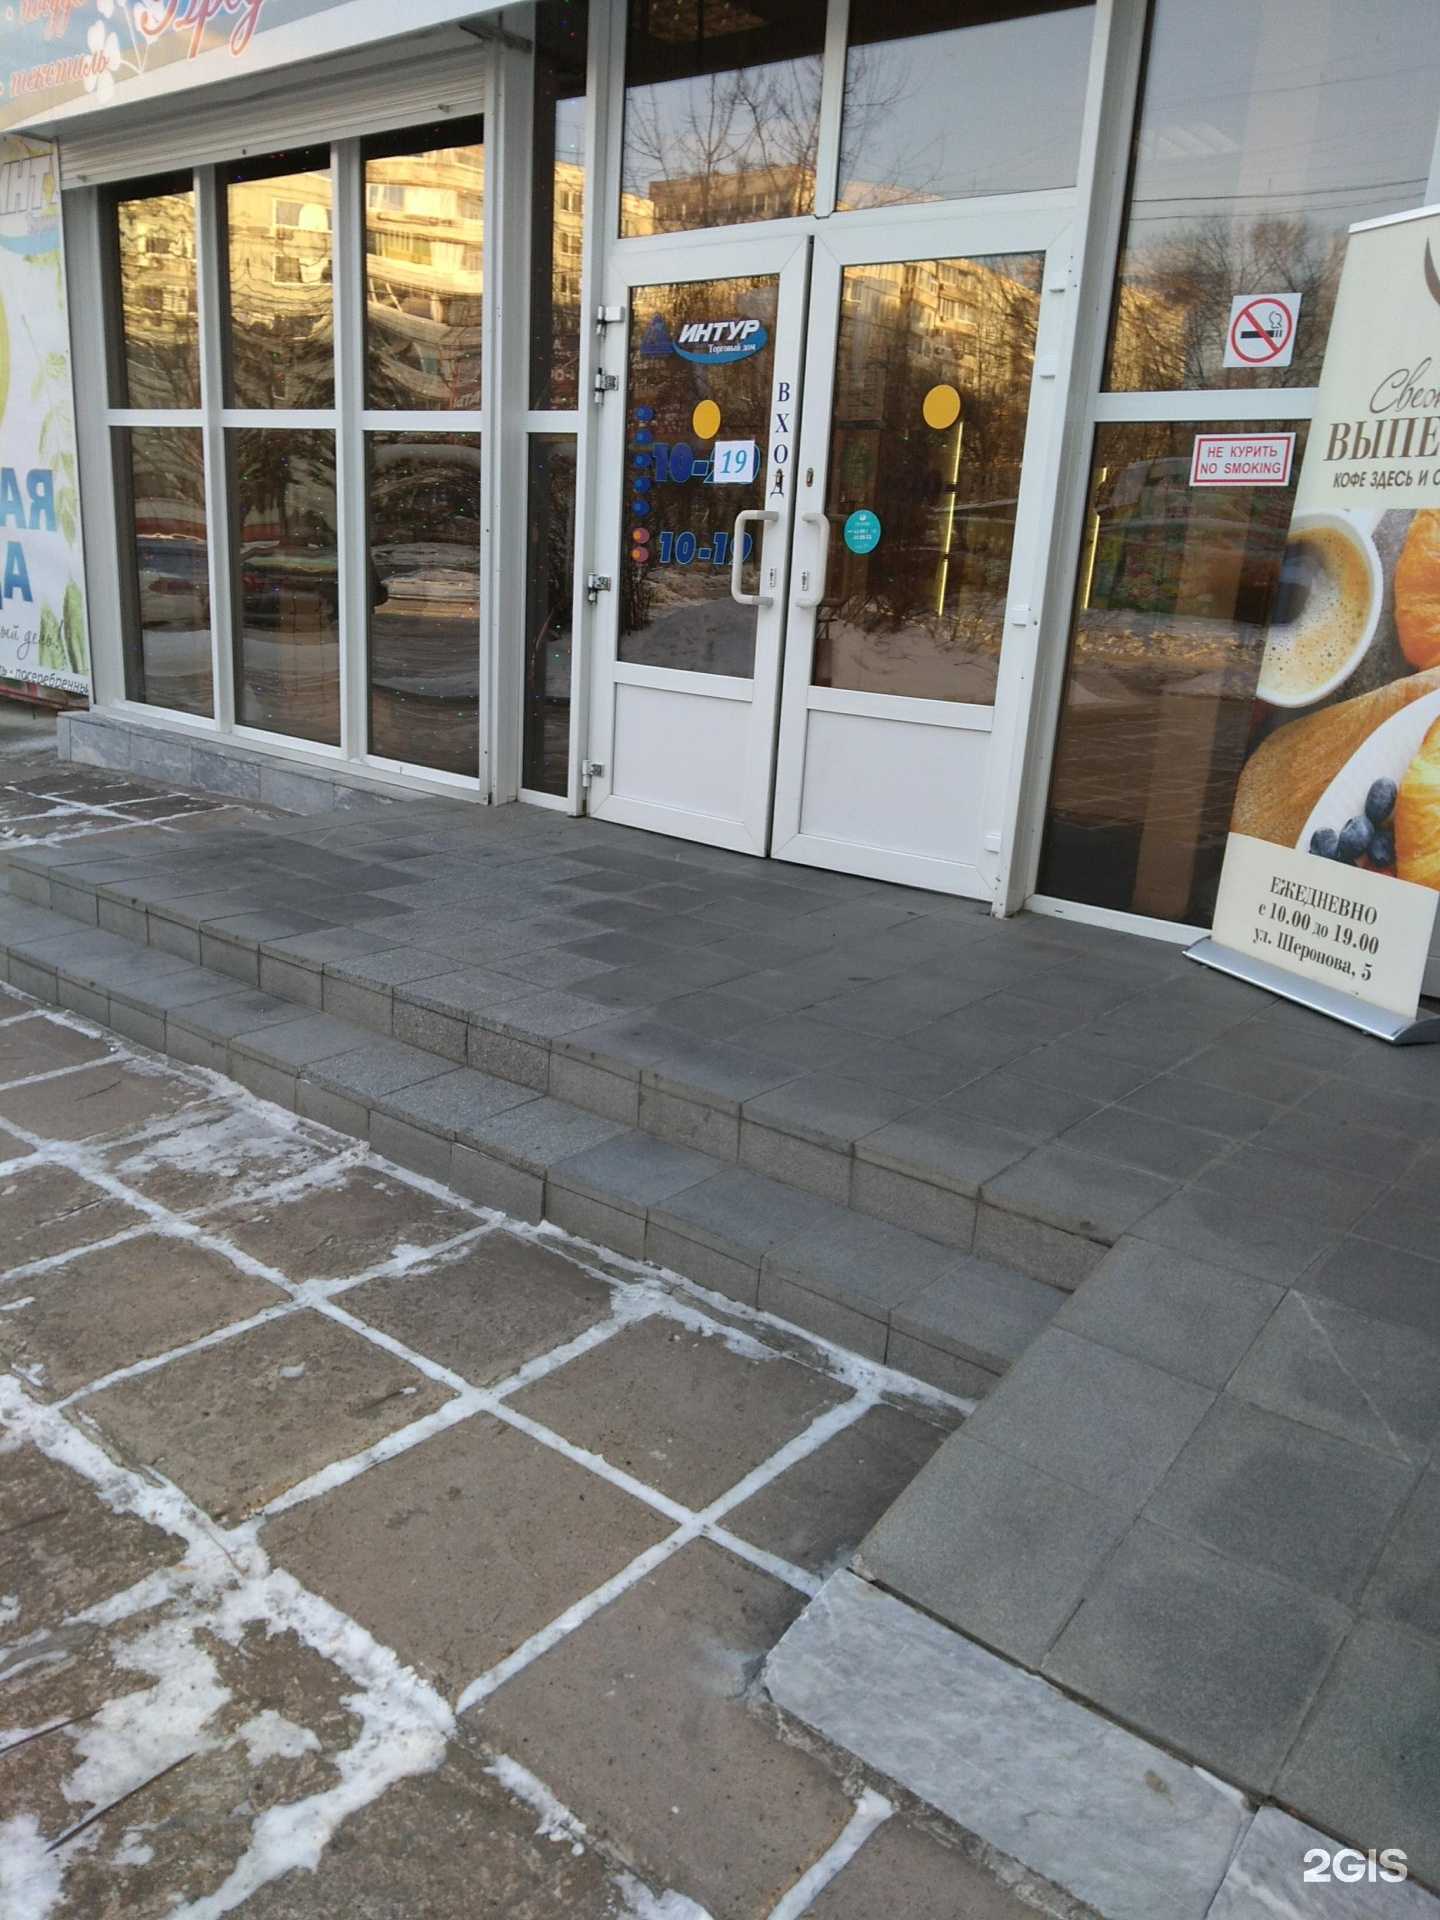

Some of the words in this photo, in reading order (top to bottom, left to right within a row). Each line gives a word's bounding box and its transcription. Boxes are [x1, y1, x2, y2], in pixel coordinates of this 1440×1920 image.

[679, 319, 760, 343] ИНТУР
[770, 382, 790, 498] ВХОД
[1208, 446, 1223, 458] НЕ
[1230, 445, 1278, 457] КУРИТЬ
[720, 449, 747, 474] 19
[1200, 463, 1217, 474] NO
[1224, 462, 1281, 474] SMOKING
[1333, 471, 1366, 488] КОФЕ
[1370, 470, 1413, 489] ЗДЕСЬ
[1418, 469, 1429, 486] И
[1270, 876, 1377, 925] ЕЖЕДНЕВНО
[1258, 903, 1266, 916] с
[1270, 902, 1311, 931] 10.00
[1312, 921, 1329, 938] до
[1334, 924, 1379, 954] 19.00
[1253, 927, 1272, 945] ул.
[1277, 931, 1356, 977] Шеронова,
[1361, 963, 1373, 981] 5
